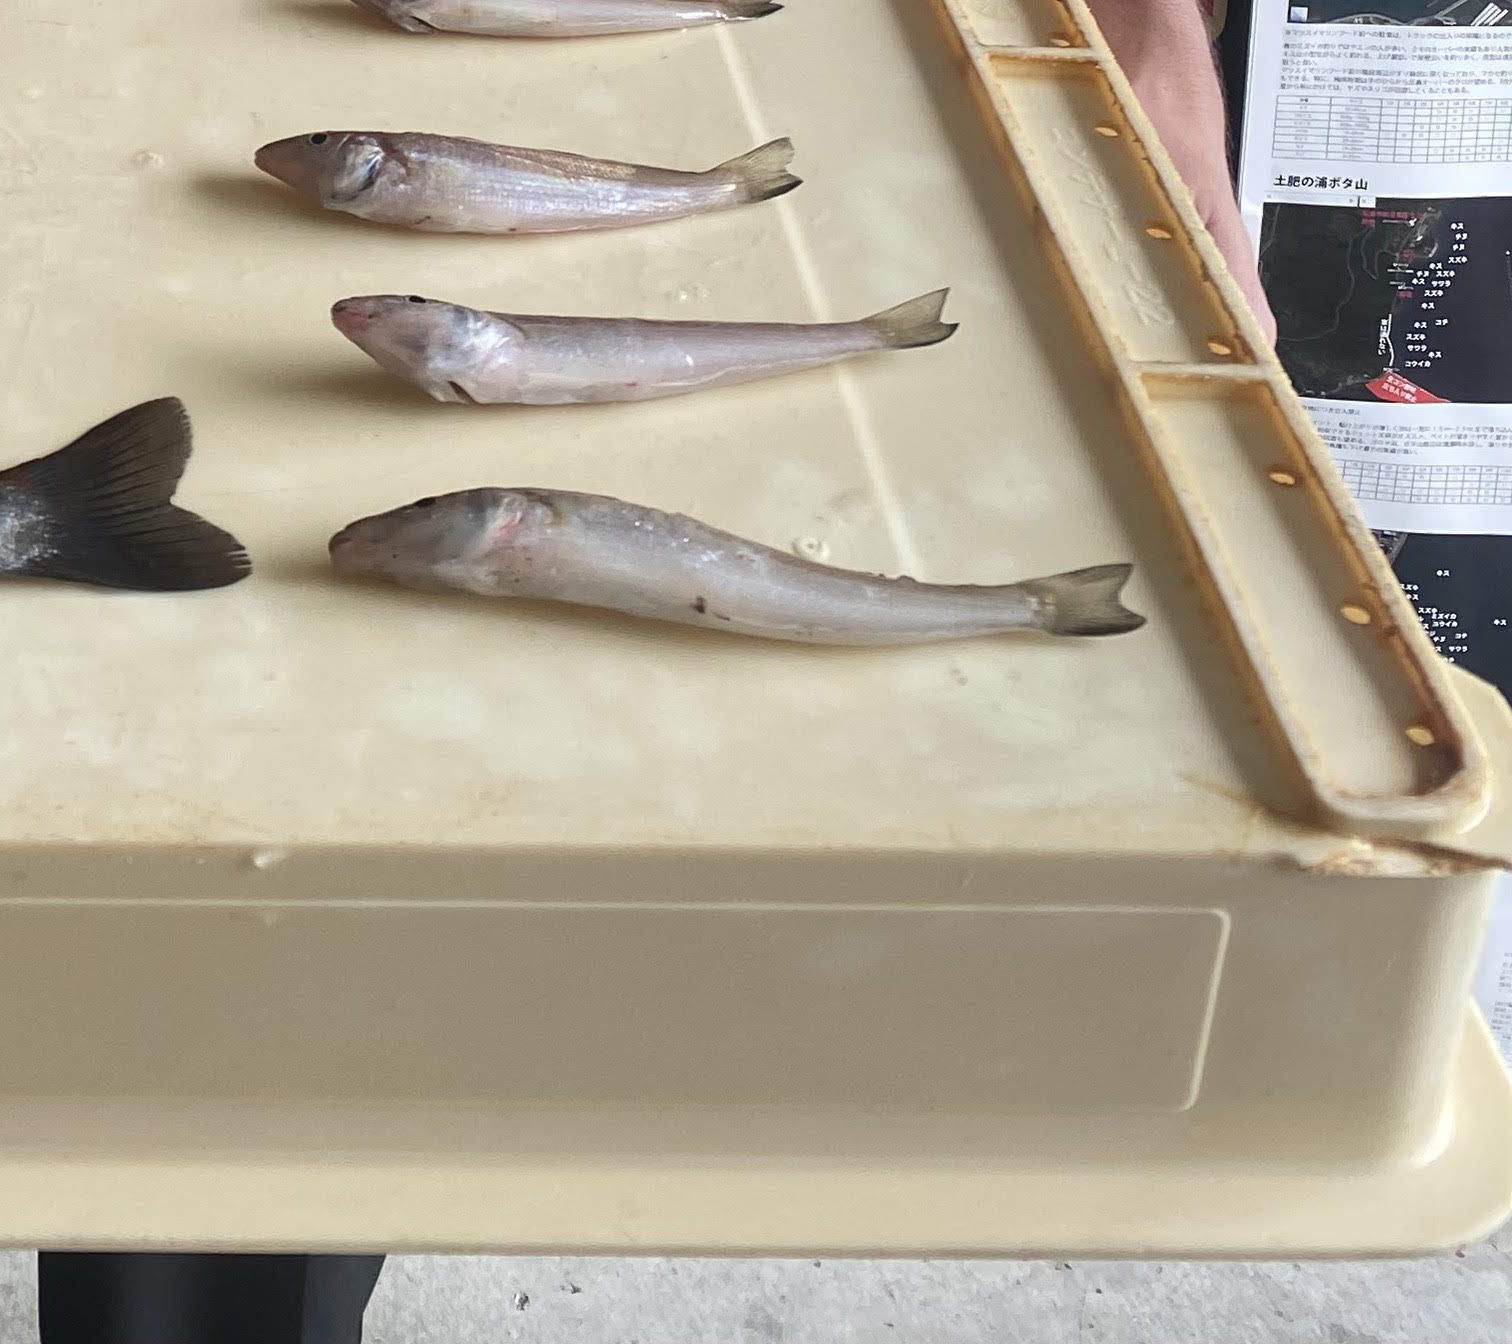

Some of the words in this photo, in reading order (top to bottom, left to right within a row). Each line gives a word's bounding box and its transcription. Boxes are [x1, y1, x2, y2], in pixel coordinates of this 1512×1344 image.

[1274, 175, 1368, 191] 土肥の浦ボタ山
